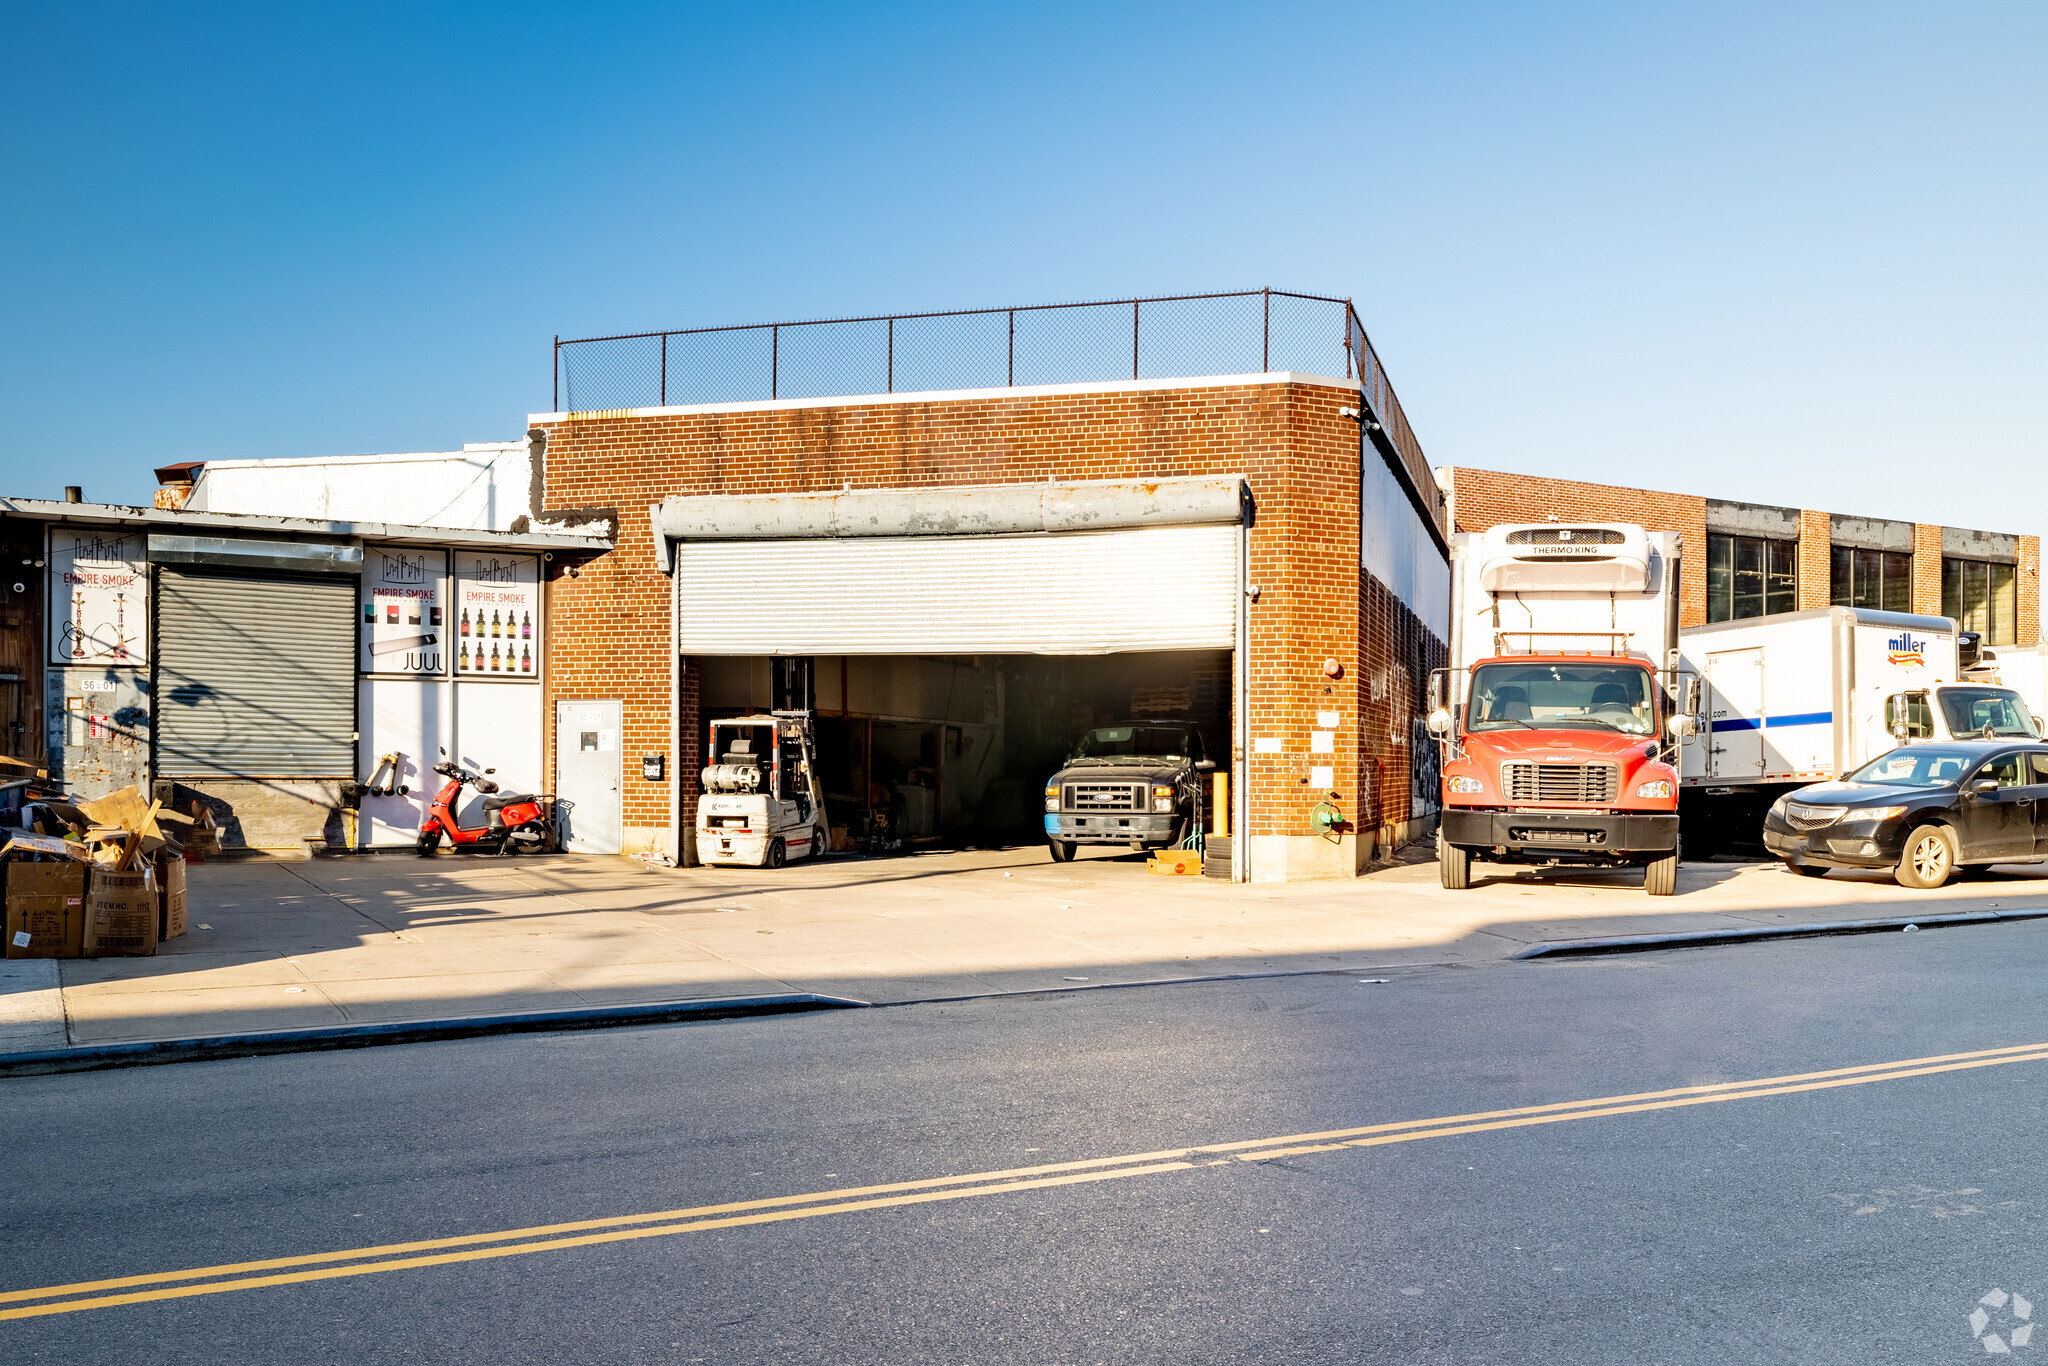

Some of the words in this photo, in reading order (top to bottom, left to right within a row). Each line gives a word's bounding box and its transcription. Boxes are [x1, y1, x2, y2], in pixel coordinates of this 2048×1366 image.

[1574, 546, 1598, 554] KING
[63, 572, 99, 585] EMPIRE
[102, 574, 135, 586] SMOKE
[372, 587, 404, 599] EMPIRE
[405, 588, 435, 600] SMOKE
[466, 591, 496, 602] EMPIRE
[498, 592, 526, 604] SMOKE
[1888, 632, 1927, 653] miller
[403, 652, 443, 671] JUUL
[96, 901, 116, 910] ITEM
[116, 902, 129, 910] NO:
